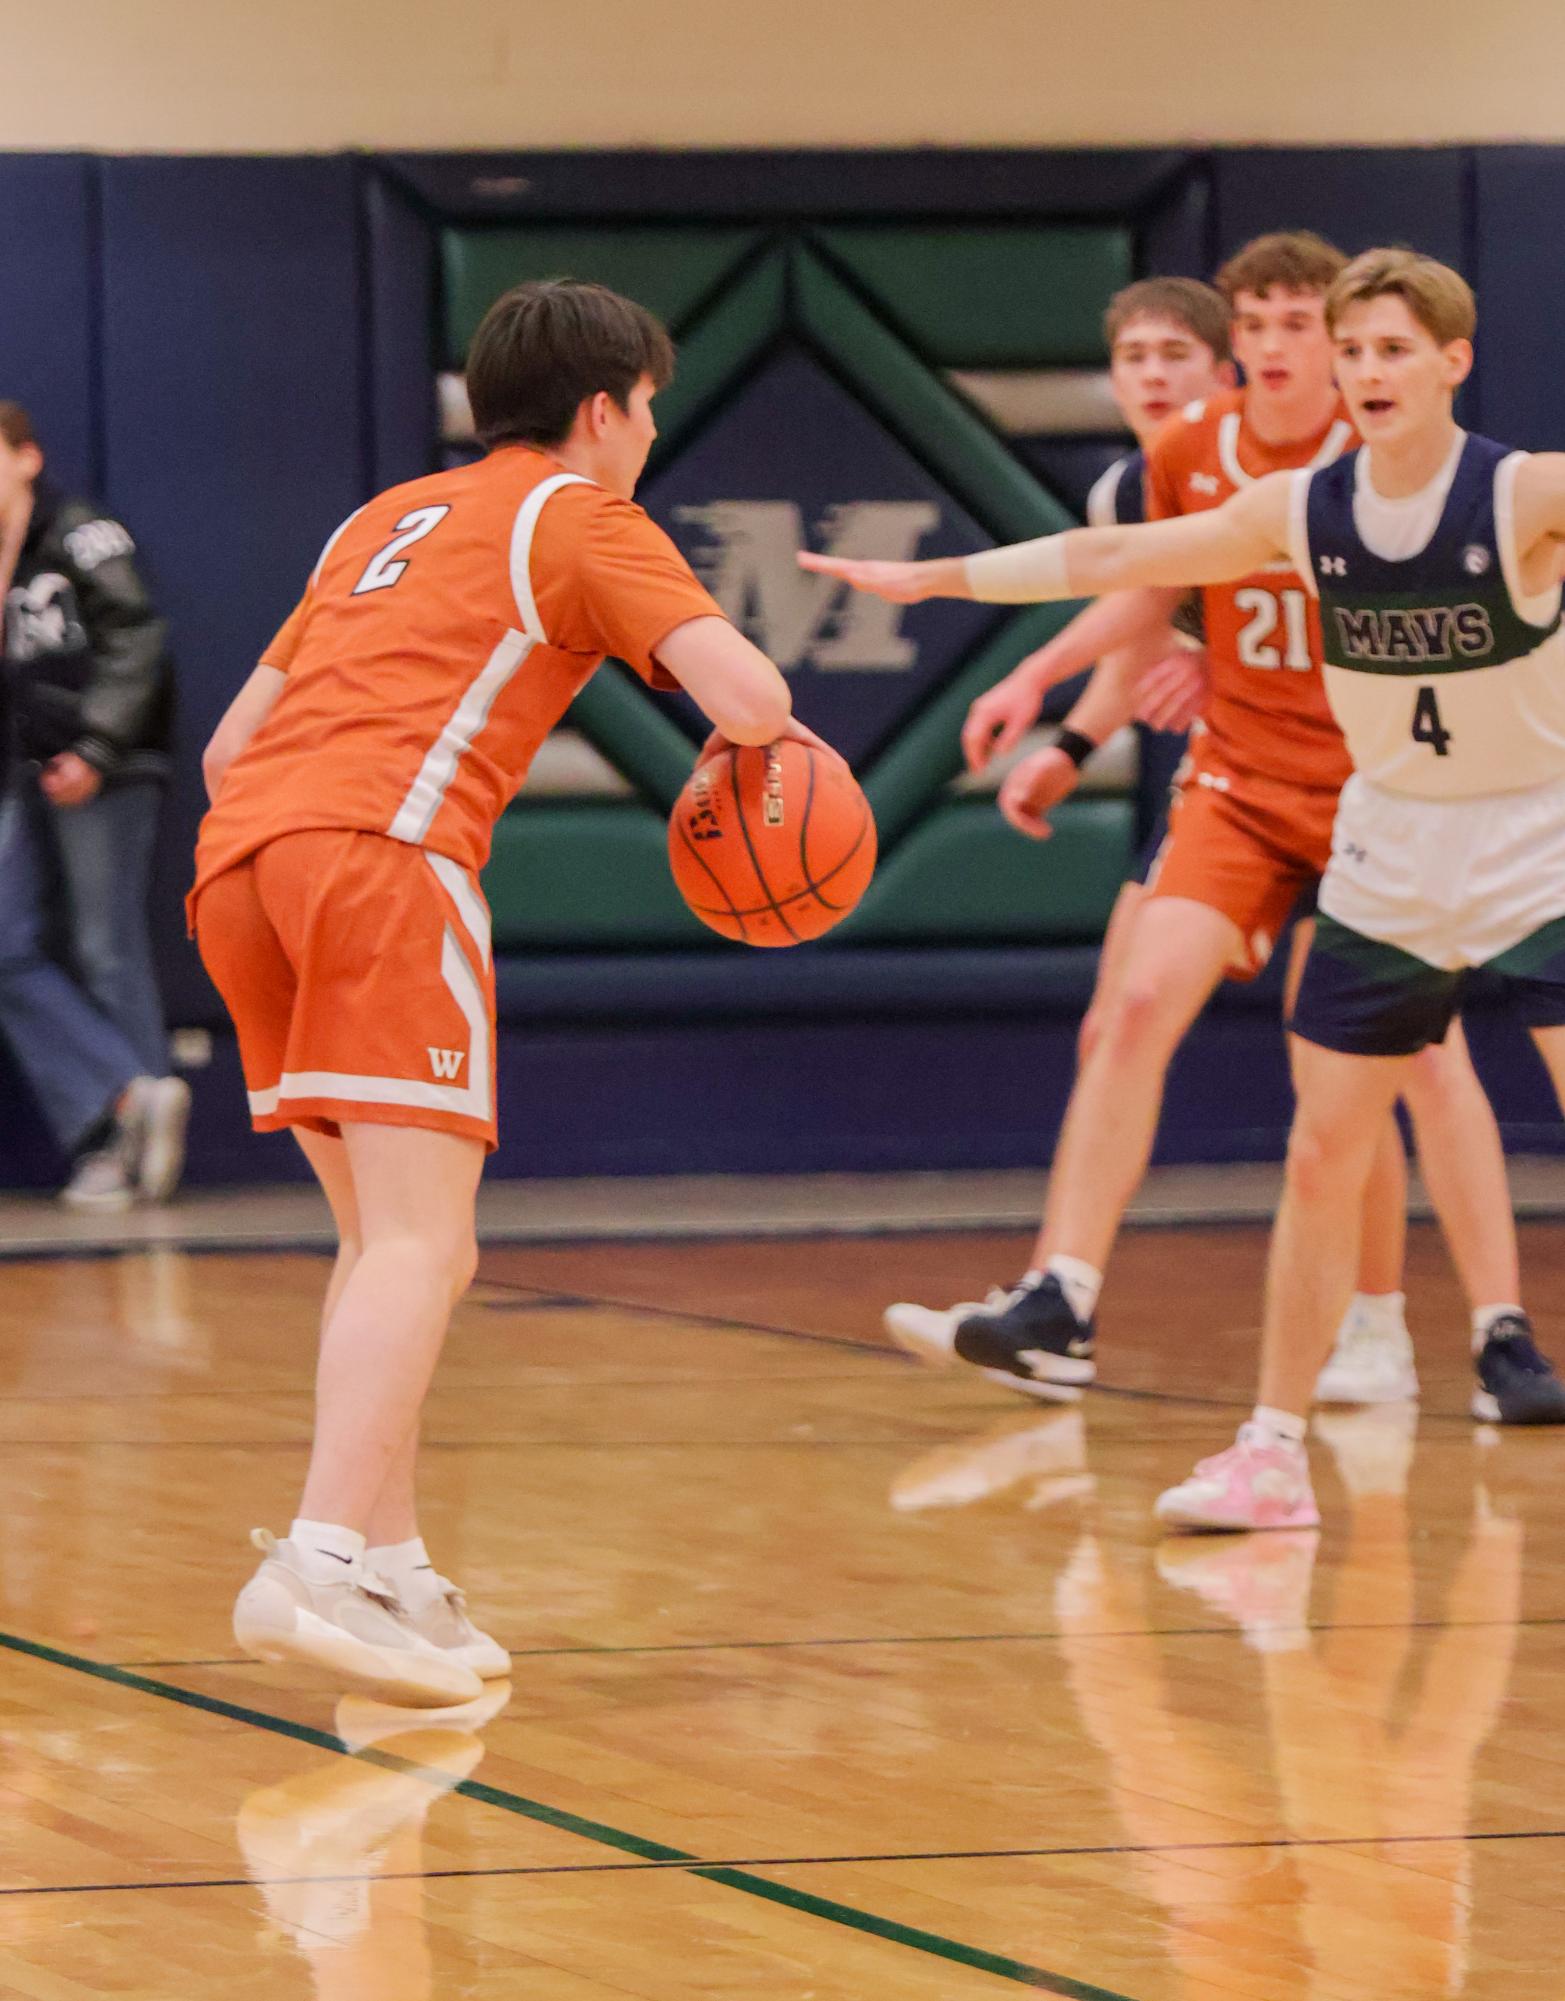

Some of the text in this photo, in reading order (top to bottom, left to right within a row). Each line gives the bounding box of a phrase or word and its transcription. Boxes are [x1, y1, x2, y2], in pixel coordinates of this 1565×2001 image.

[350, 504, 451, 596] 2
[672, 501, 941, 671] M
[1234, 588, 1311, 671] 21
[1333, 602, 1494, 662] MAVS
[1412, 686, 1450, 756] 4
[427, 1047, 465, 1079] W
